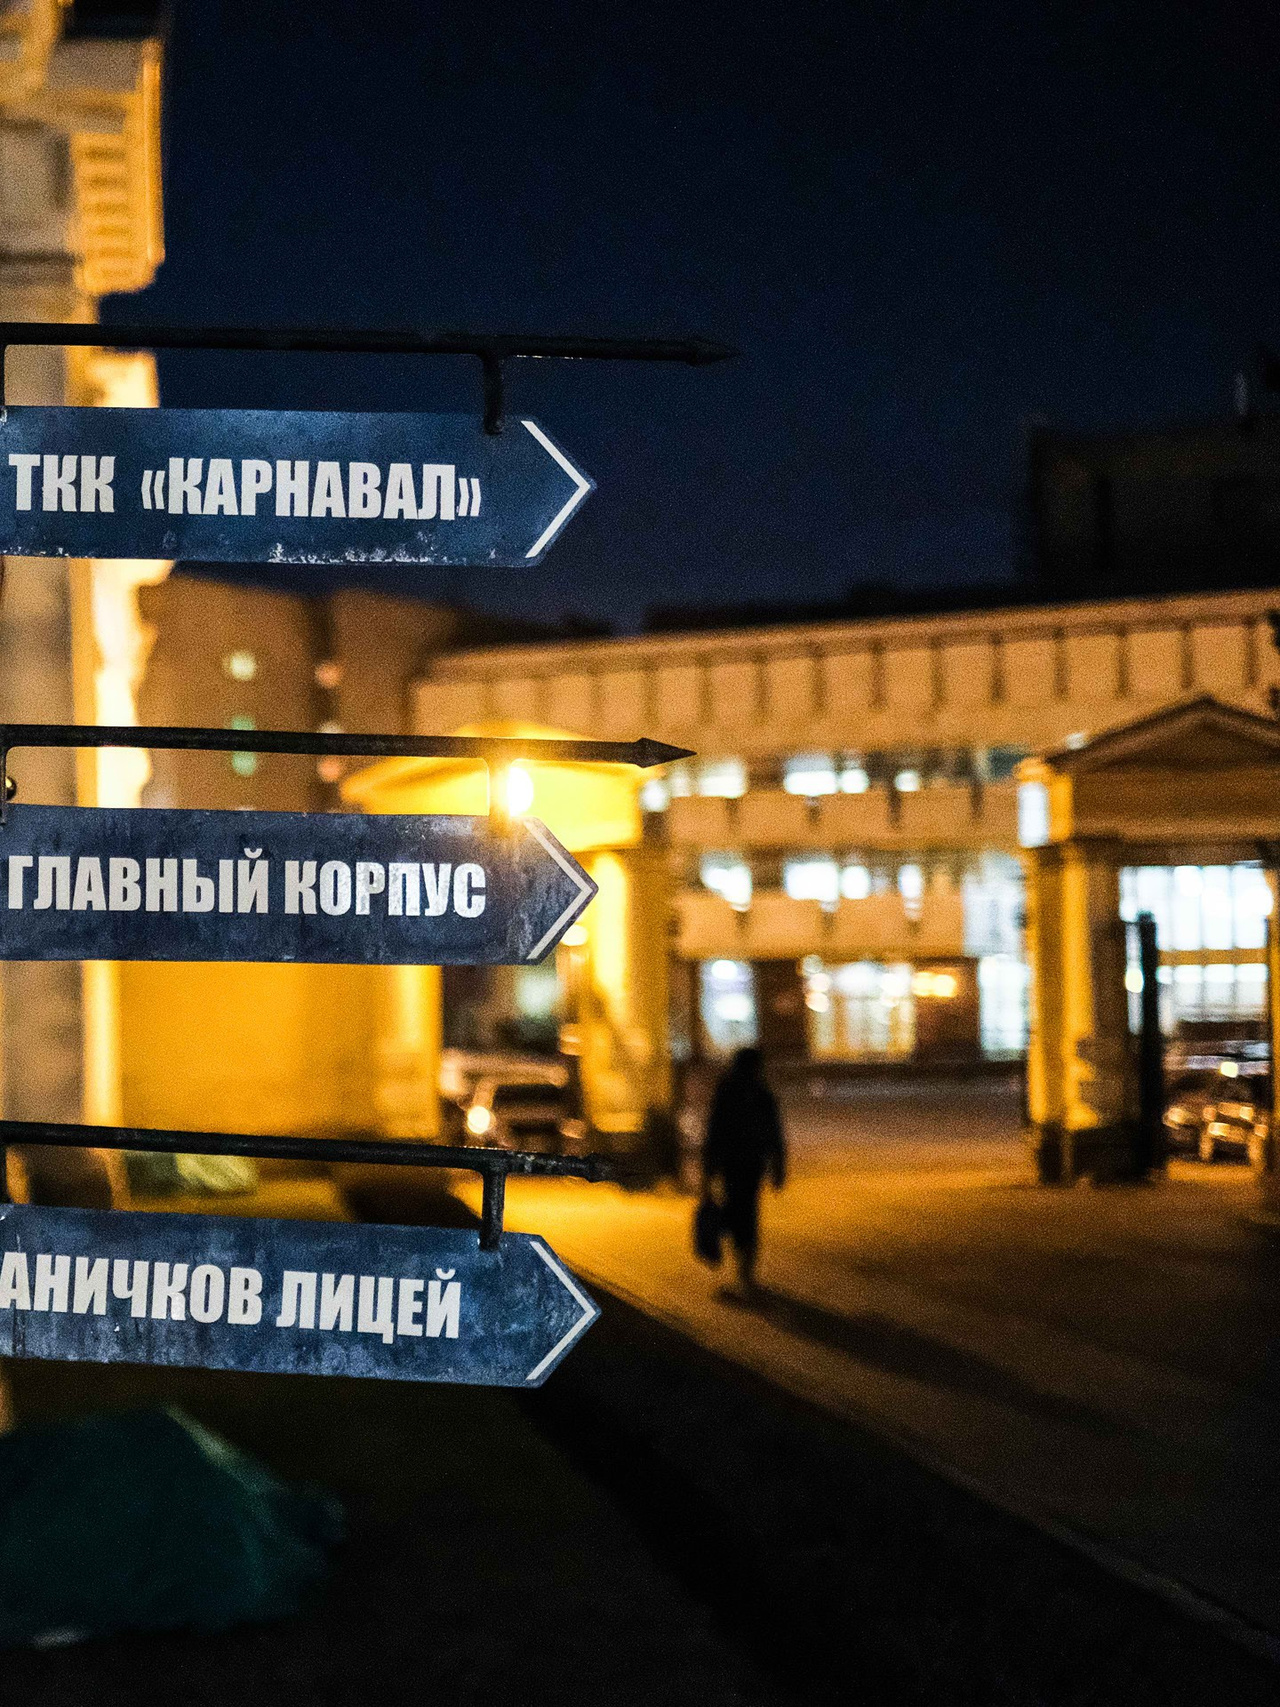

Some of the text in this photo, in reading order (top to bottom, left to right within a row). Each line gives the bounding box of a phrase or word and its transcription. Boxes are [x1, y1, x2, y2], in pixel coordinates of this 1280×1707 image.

[8, 453, 483, 521] ТКК «КАРНАВАЛ»
[6, 847, 489, 919] ГЛАВНЫЙ КОРПУС
[274, 1267, 463, 1345] ЛИЦЕЙ
